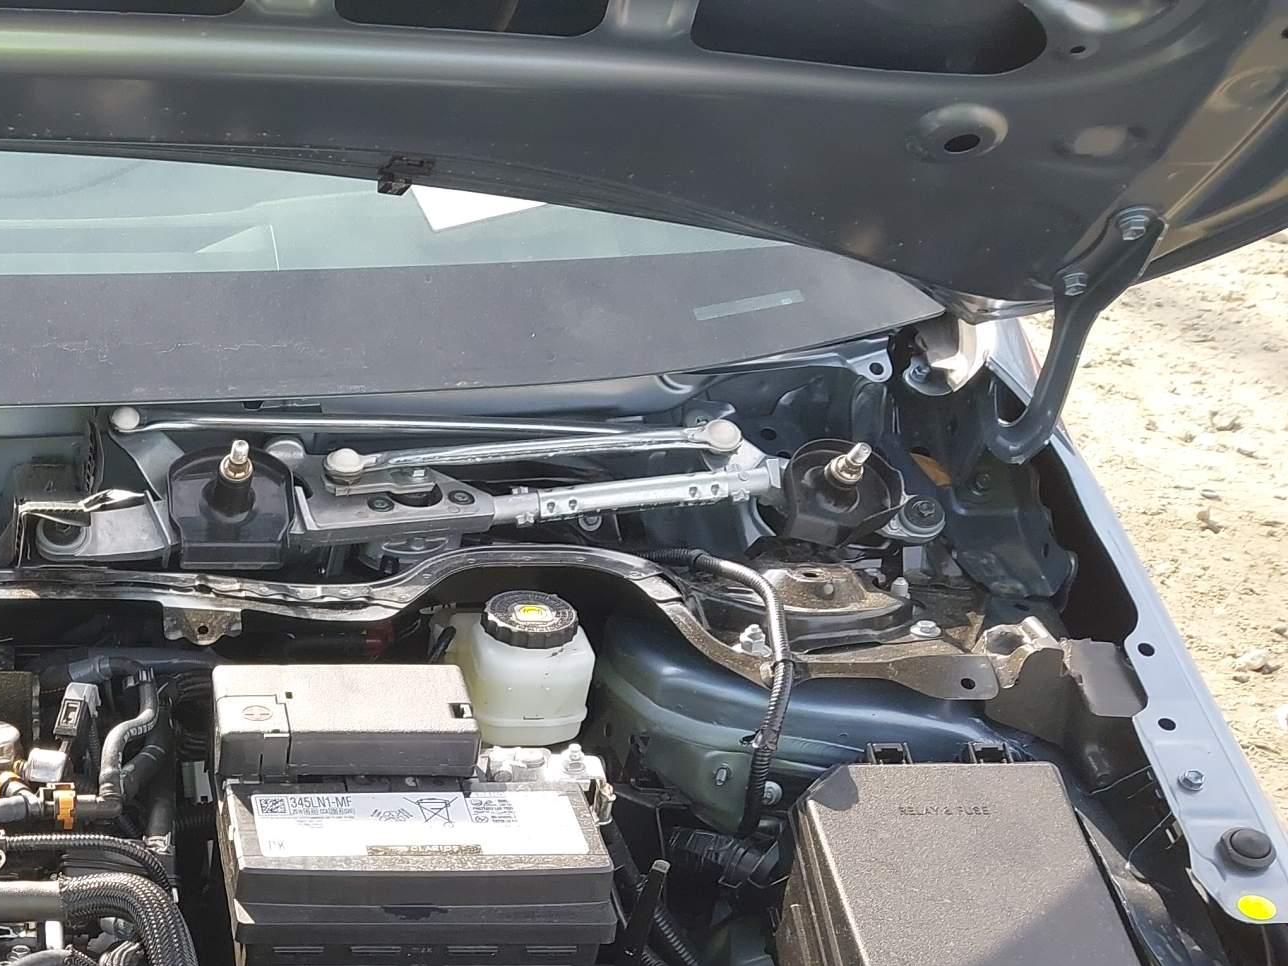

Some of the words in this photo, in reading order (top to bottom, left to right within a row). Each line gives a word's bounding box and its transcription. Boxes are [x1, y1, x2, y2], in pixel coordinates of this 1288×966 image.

[289, 795, 353, 809] 345LN1-MF
[898, 806, 939, 816] RELAY
[955, 806, 992, 816] FUSE
